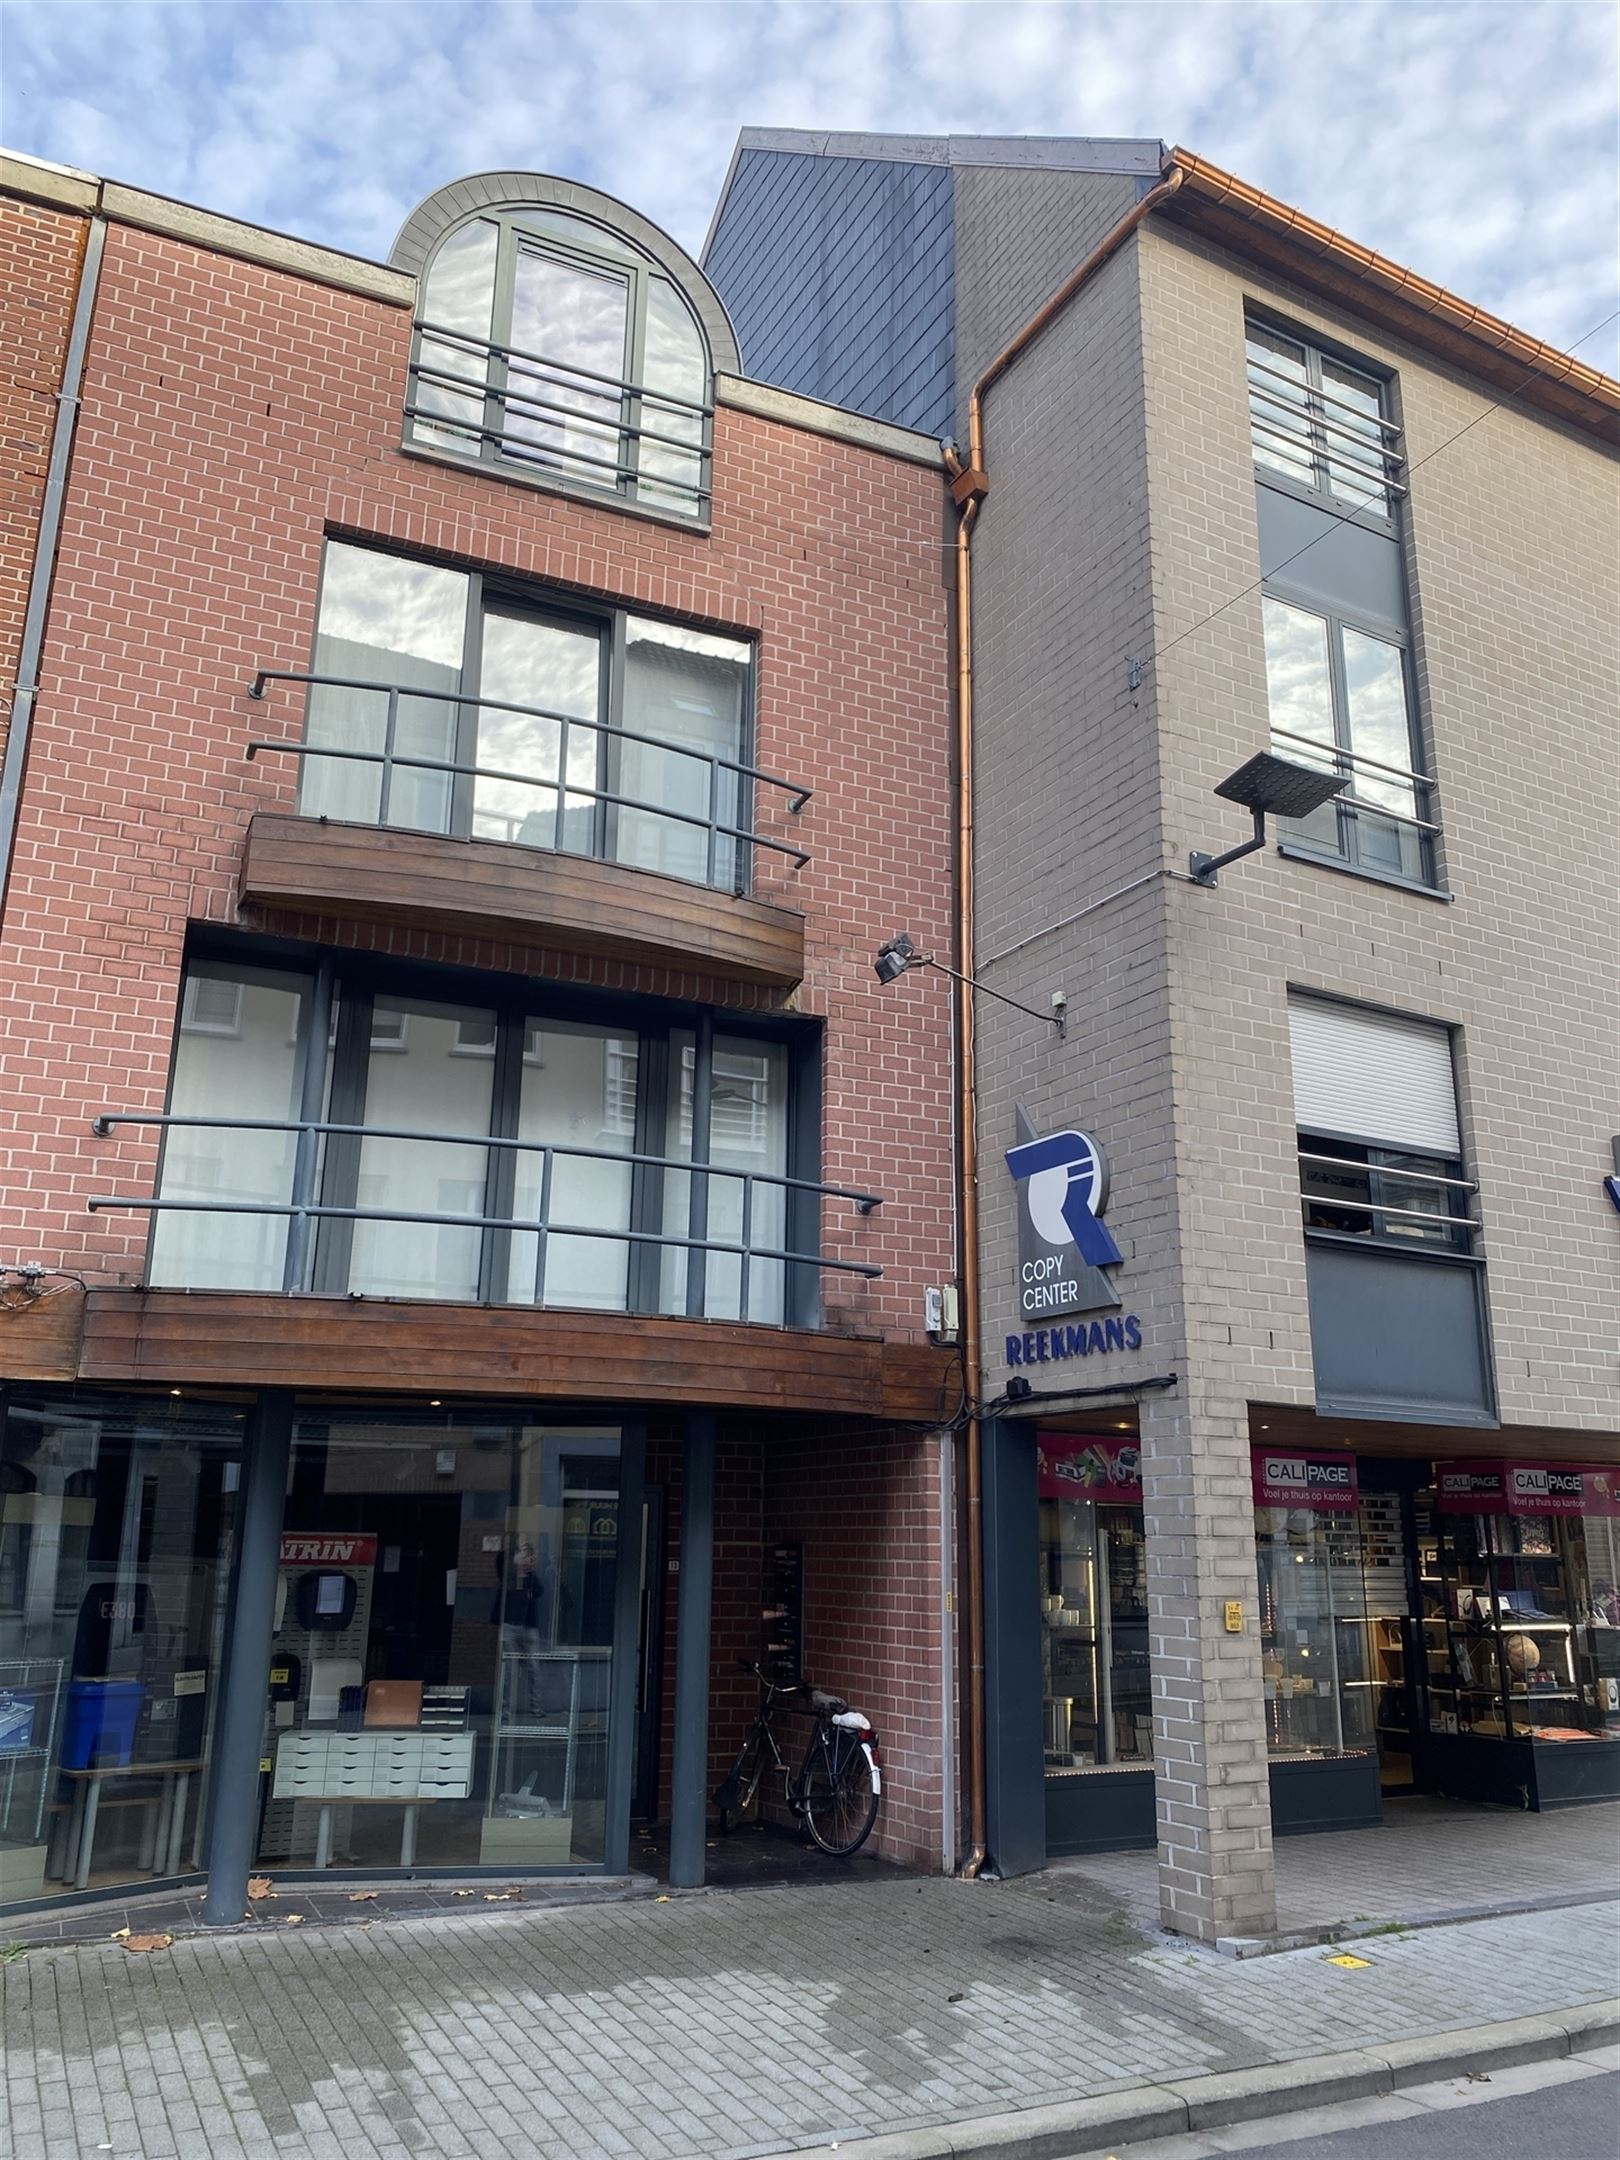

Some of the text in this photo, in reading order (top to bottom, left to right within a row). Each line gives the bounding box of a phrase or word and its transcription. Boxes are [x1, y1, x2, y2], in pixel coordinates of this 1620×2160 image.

[1022, 1254, 1064, 1283] COPY
[1023, 1280, 1078, 1310] CENTER
[1006, 1315, 1142, 1365] REEKMANS
[1263, 1488, 1352, 1502] Voel je thuis op kantoor
[1513, 1497, 1586, 1508] Voel je thuis op kantoor
